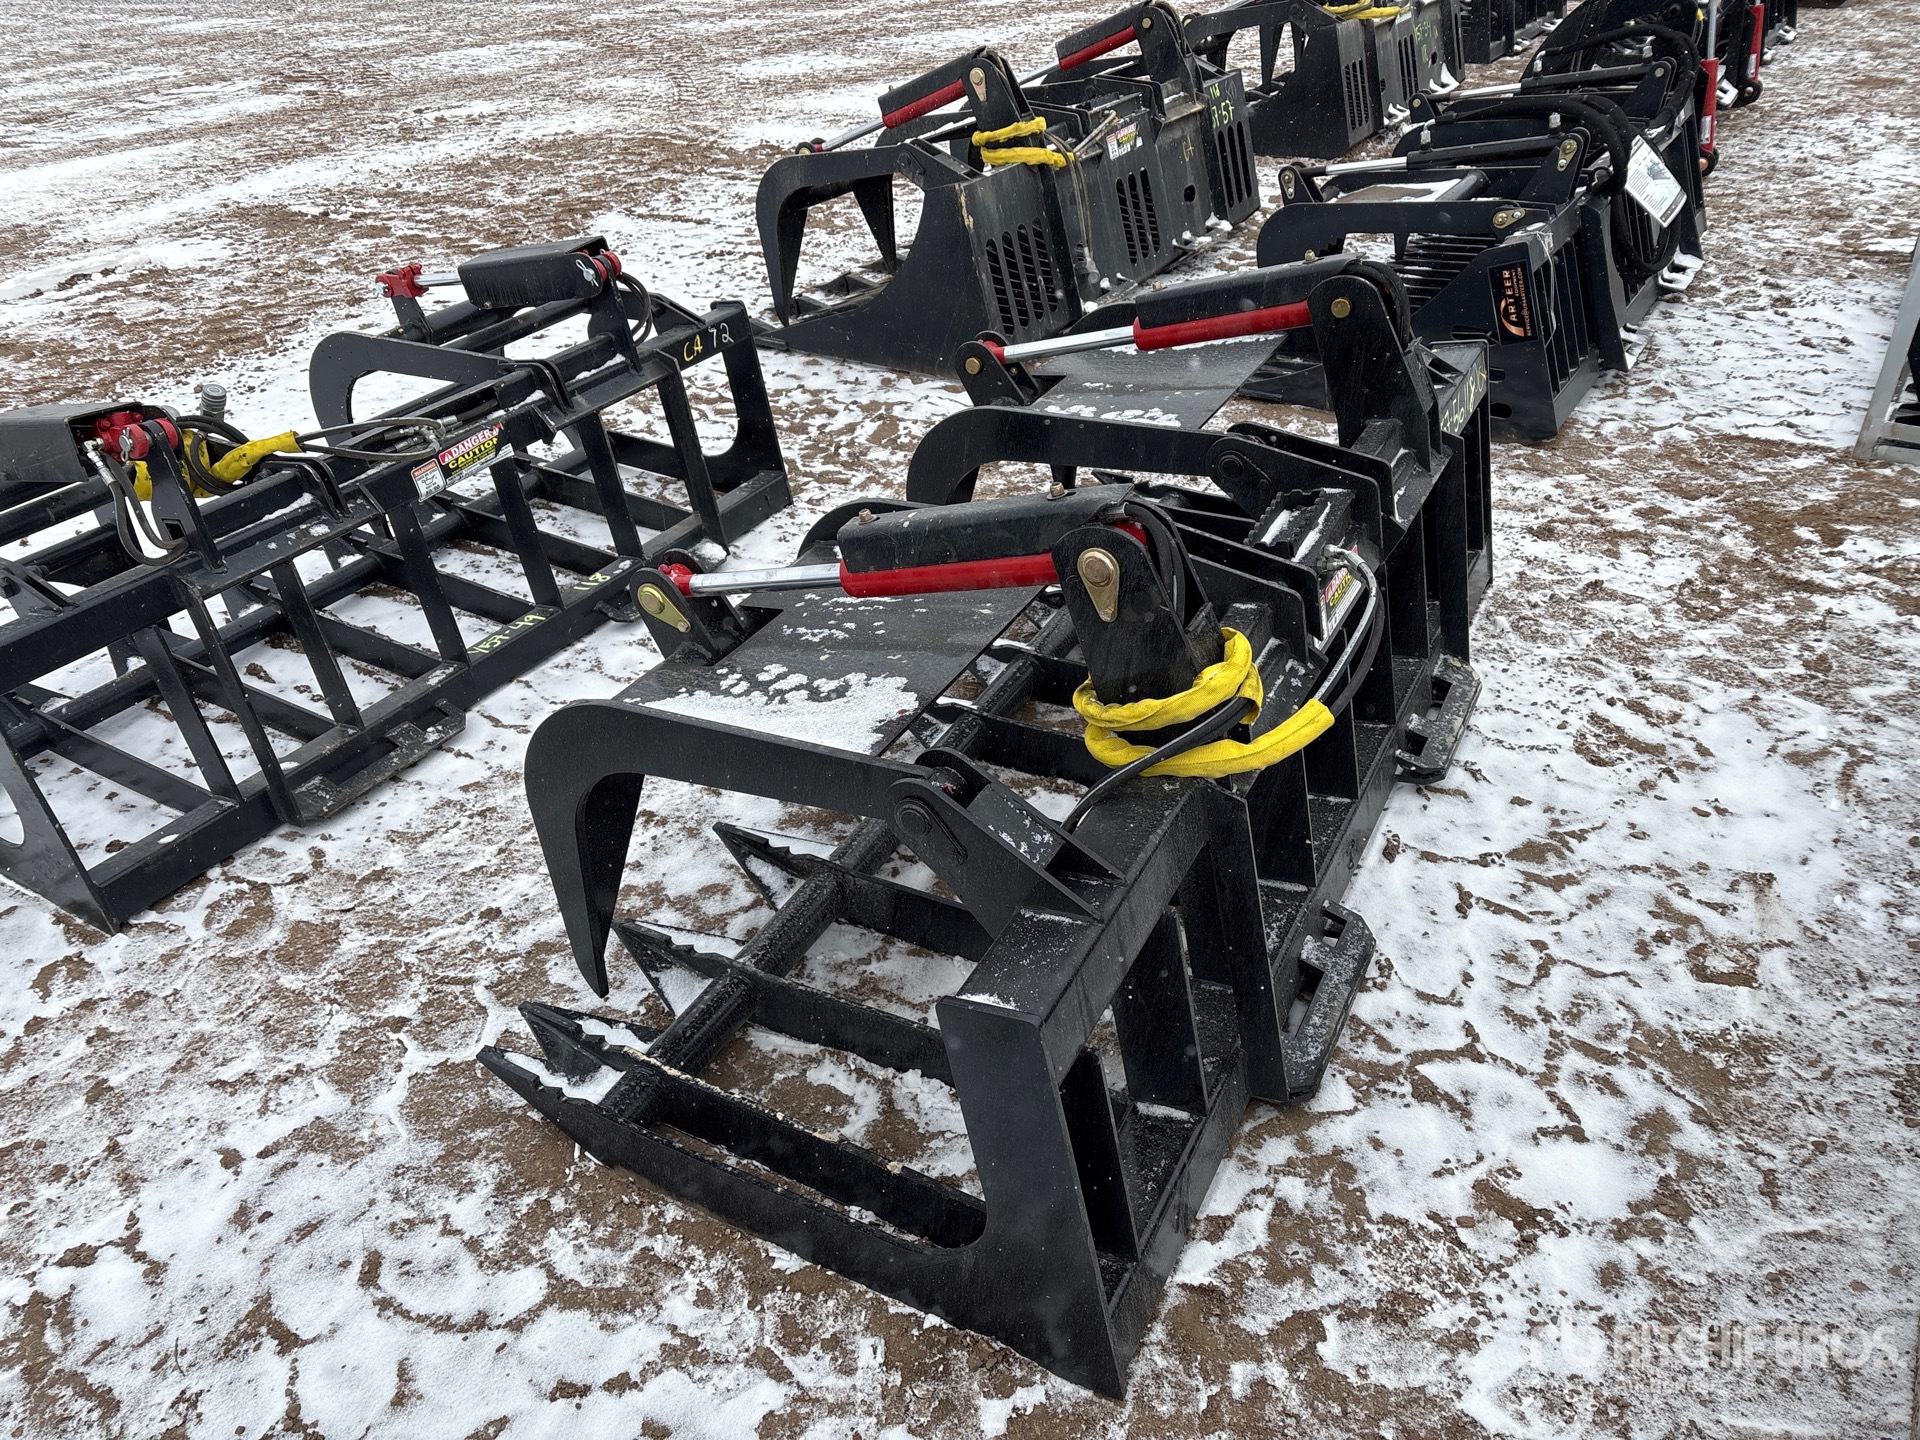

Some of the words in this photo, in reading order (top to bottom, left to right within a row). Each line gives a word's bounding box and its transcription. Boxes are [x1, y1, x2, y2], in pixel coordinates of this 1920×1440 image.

[1502, 269, 1518, 322] ARTEER
[683, 333, 703, 361] CA
[451, 427, 493, 459] DANGER
[573, 572, 611, 591] 118
